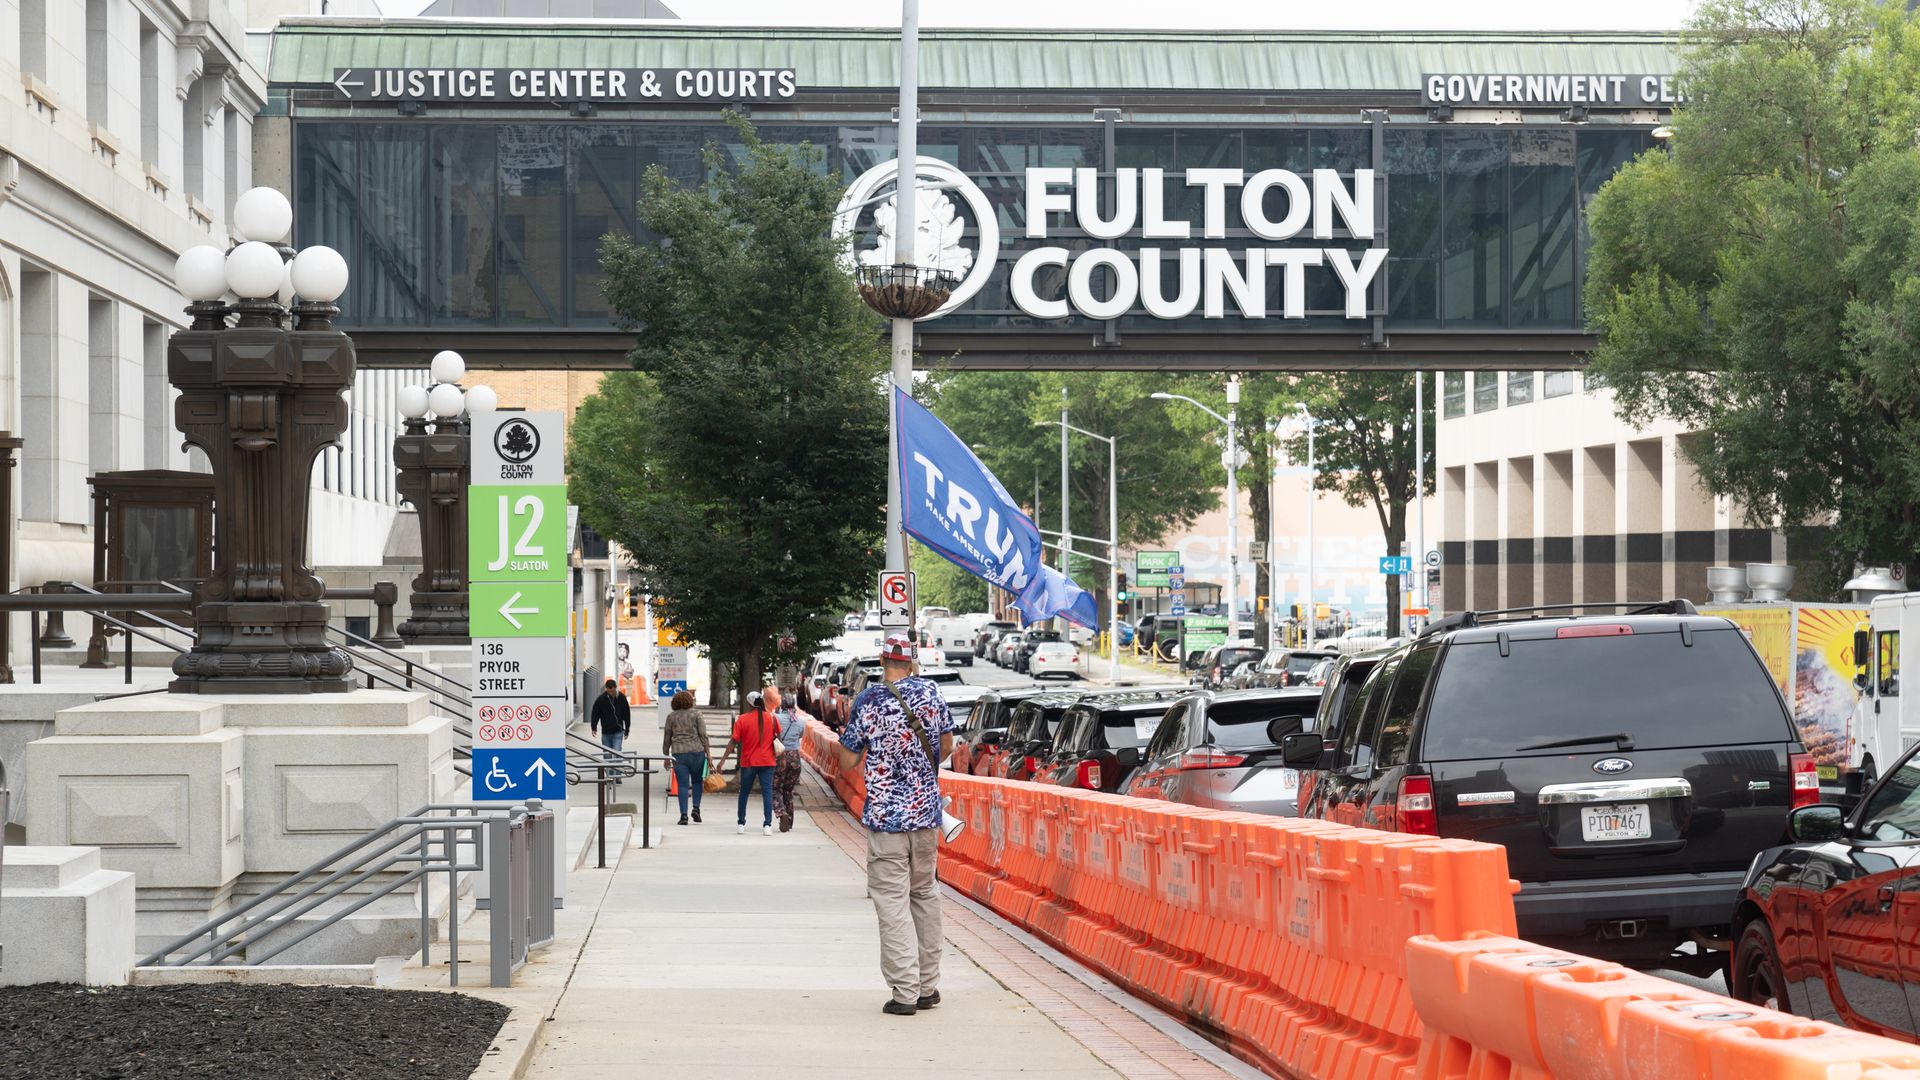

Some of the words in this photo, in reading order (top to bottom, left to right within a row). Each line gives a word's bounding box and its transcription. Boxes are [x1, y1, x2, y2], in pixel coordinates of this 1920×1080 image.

[371, 69, 496, 98] JUSTICE
[508, 69, 627, 98] CENTER
[640, 70, 663, 98] &
[675, 69, 796, 98] COURTS
[1427, 74, 1623, 103] GOVERNMENT
[1025, 167, 1375, 240] FULTON
[1010, 247, 1389, 321] COUNTY
[501, 464, 533, 472] FULTON
[500, 471, 534, 479] COUNTY
[925, 498, 951, 531] MAKE
[488, 495, 544, 572] J2
[510, 560, 549, 571] SLATON
[1141, 558, 1165, 566] PARK
[1399, 558, 1408, 571] J1
[1172, 580, 1183, 588] 75
[1172, 595, 1183, 603] 85
[480, 643, 504, 656] 136
[479, 661, 520, 673] PRYOR
[479, 678, 526, 691] STREET
[1602, 760, 1624, 771] Ford
[1458, 792, 1513, 802] EXPEDITION
[1597, 807, 1633, 815] GEORGIA
